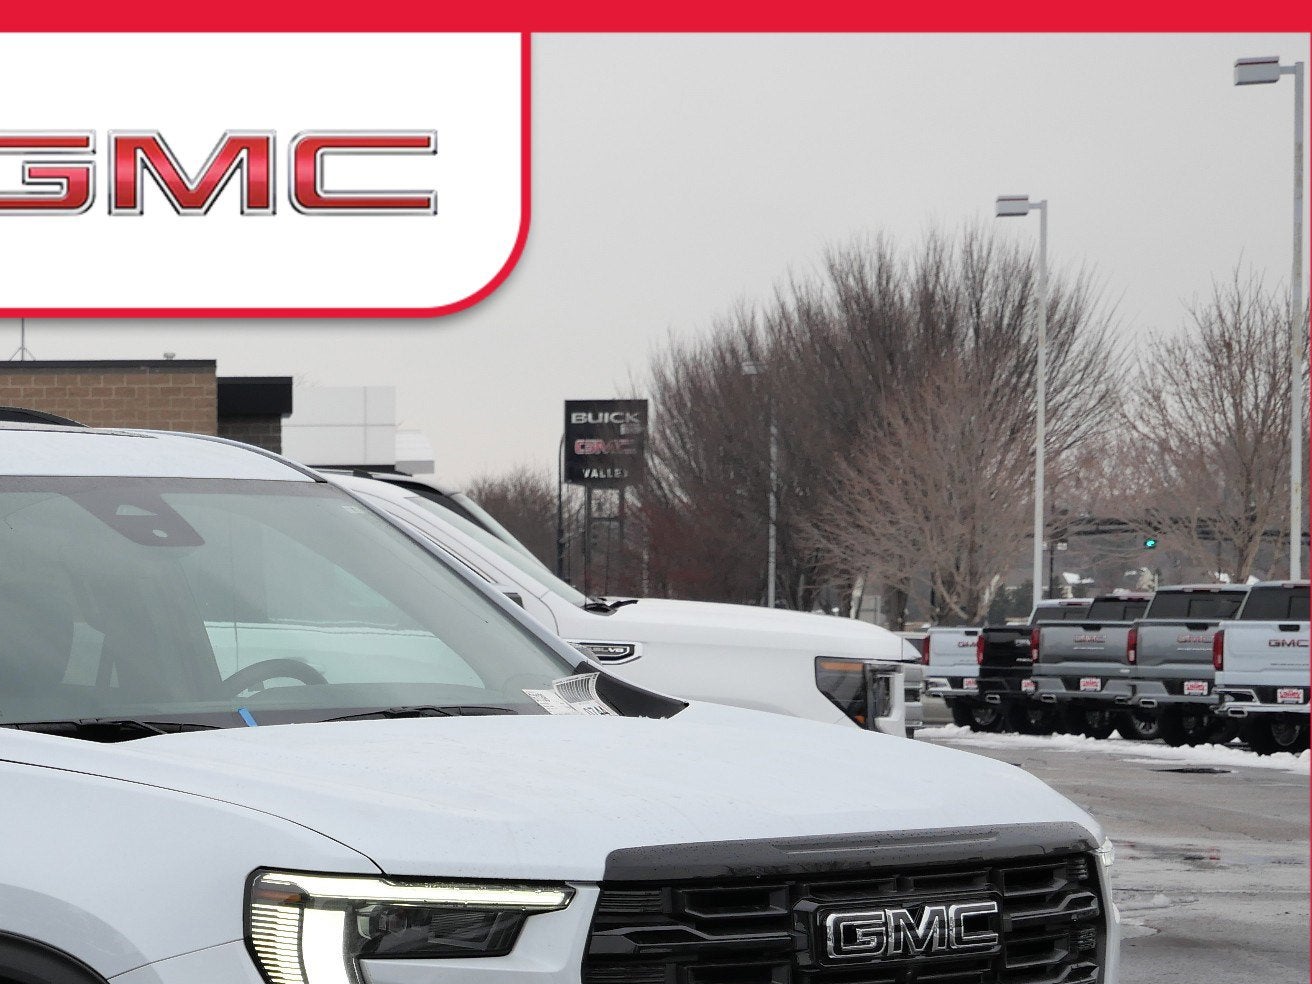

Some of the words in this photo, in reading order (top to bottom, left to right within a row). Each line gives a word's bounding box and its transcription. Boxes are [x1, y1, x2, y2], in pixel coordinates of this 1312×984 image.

[570, 411, 640, 424] BUICK
[1268, 638, 1310, 648] GMC
[826, 901, 999, 959] GMC
